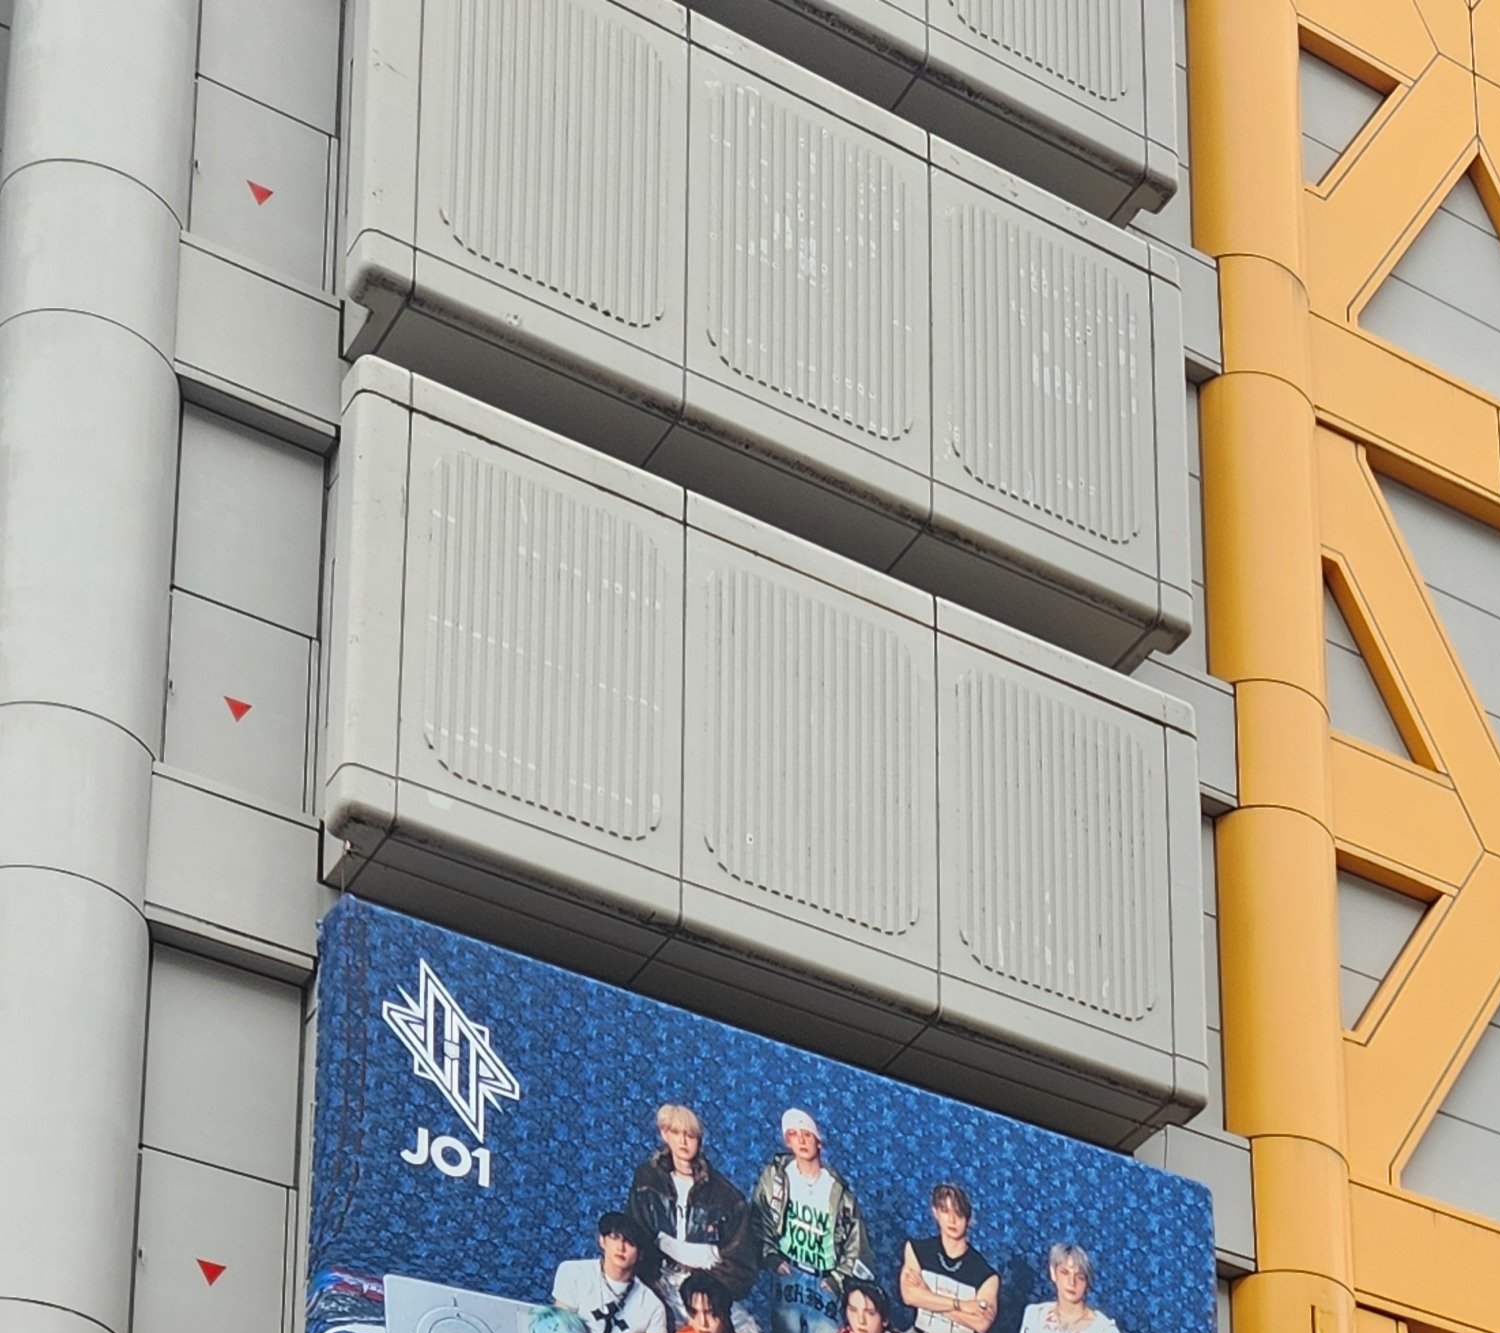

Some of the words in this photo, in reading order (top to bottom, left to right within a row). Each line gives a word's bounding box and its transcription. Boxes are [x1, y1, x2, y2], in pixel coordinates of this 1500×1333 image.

[400, 1127, 490, 1188] JO1
[787, 1200, 829, 1233] BLOW
[789, 1219, 826, 1254] YOUR
